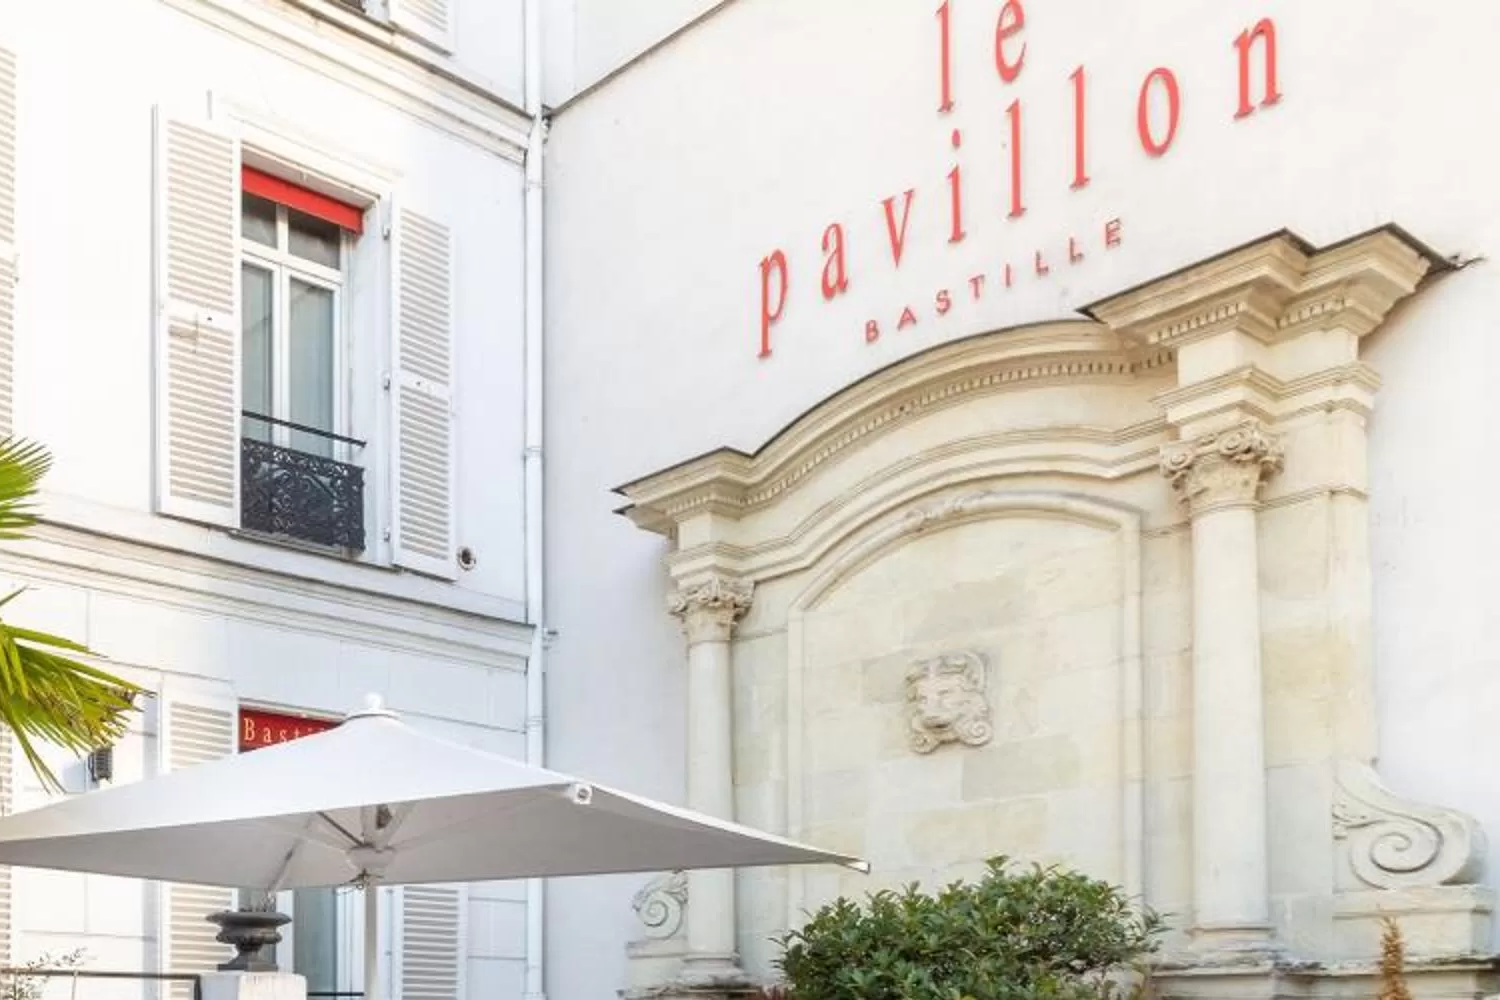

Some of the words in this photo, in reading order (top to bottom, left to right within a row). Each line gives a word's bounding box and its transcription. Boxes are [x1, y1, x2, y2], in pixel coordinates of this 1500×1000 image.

[934, 0, 1027, 113] le
[757, 15, 1283, 359] pavillon
[865, 217, 1123, 342] BASTILLE
[243, 718, 325, 743] Bast
